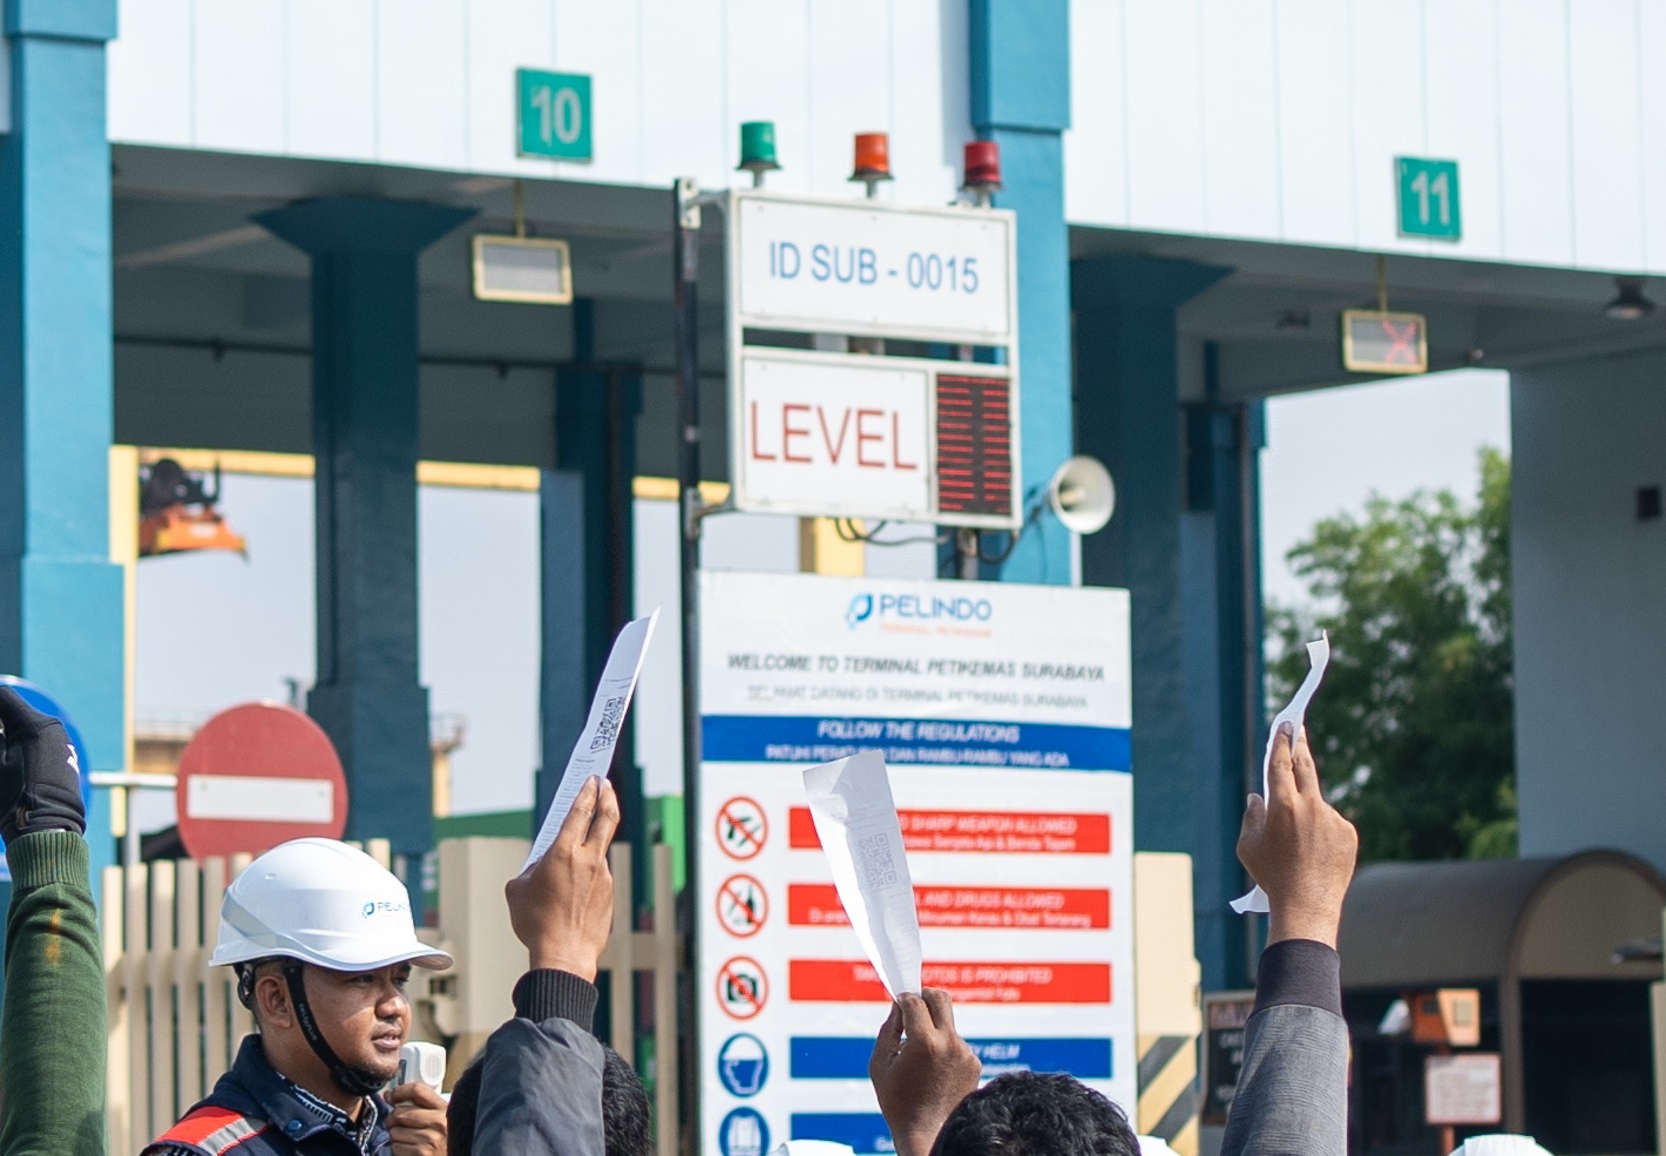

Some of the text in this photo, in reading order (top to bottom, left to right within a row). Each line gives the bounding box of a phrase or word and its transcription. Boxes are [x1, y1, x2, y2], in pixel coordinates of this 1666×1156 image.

[530, 85, 582, 146] 10
[1410, 169, 1450, 226] 11
[769, 240, 801, 279] ID
[811, 244, 878, 285] SUB
[907, 252, 979, 294] 0015
[751, 400, 918, 471] LEVEL
[880, 593, 992, 622] PELINDO
[729, 653, 1104, 682] WELCOME TO TERMINAL PETIKEMAS SURABAYA
[817, 719, 1020, 744] FOLLOW THE REGULATIONS
